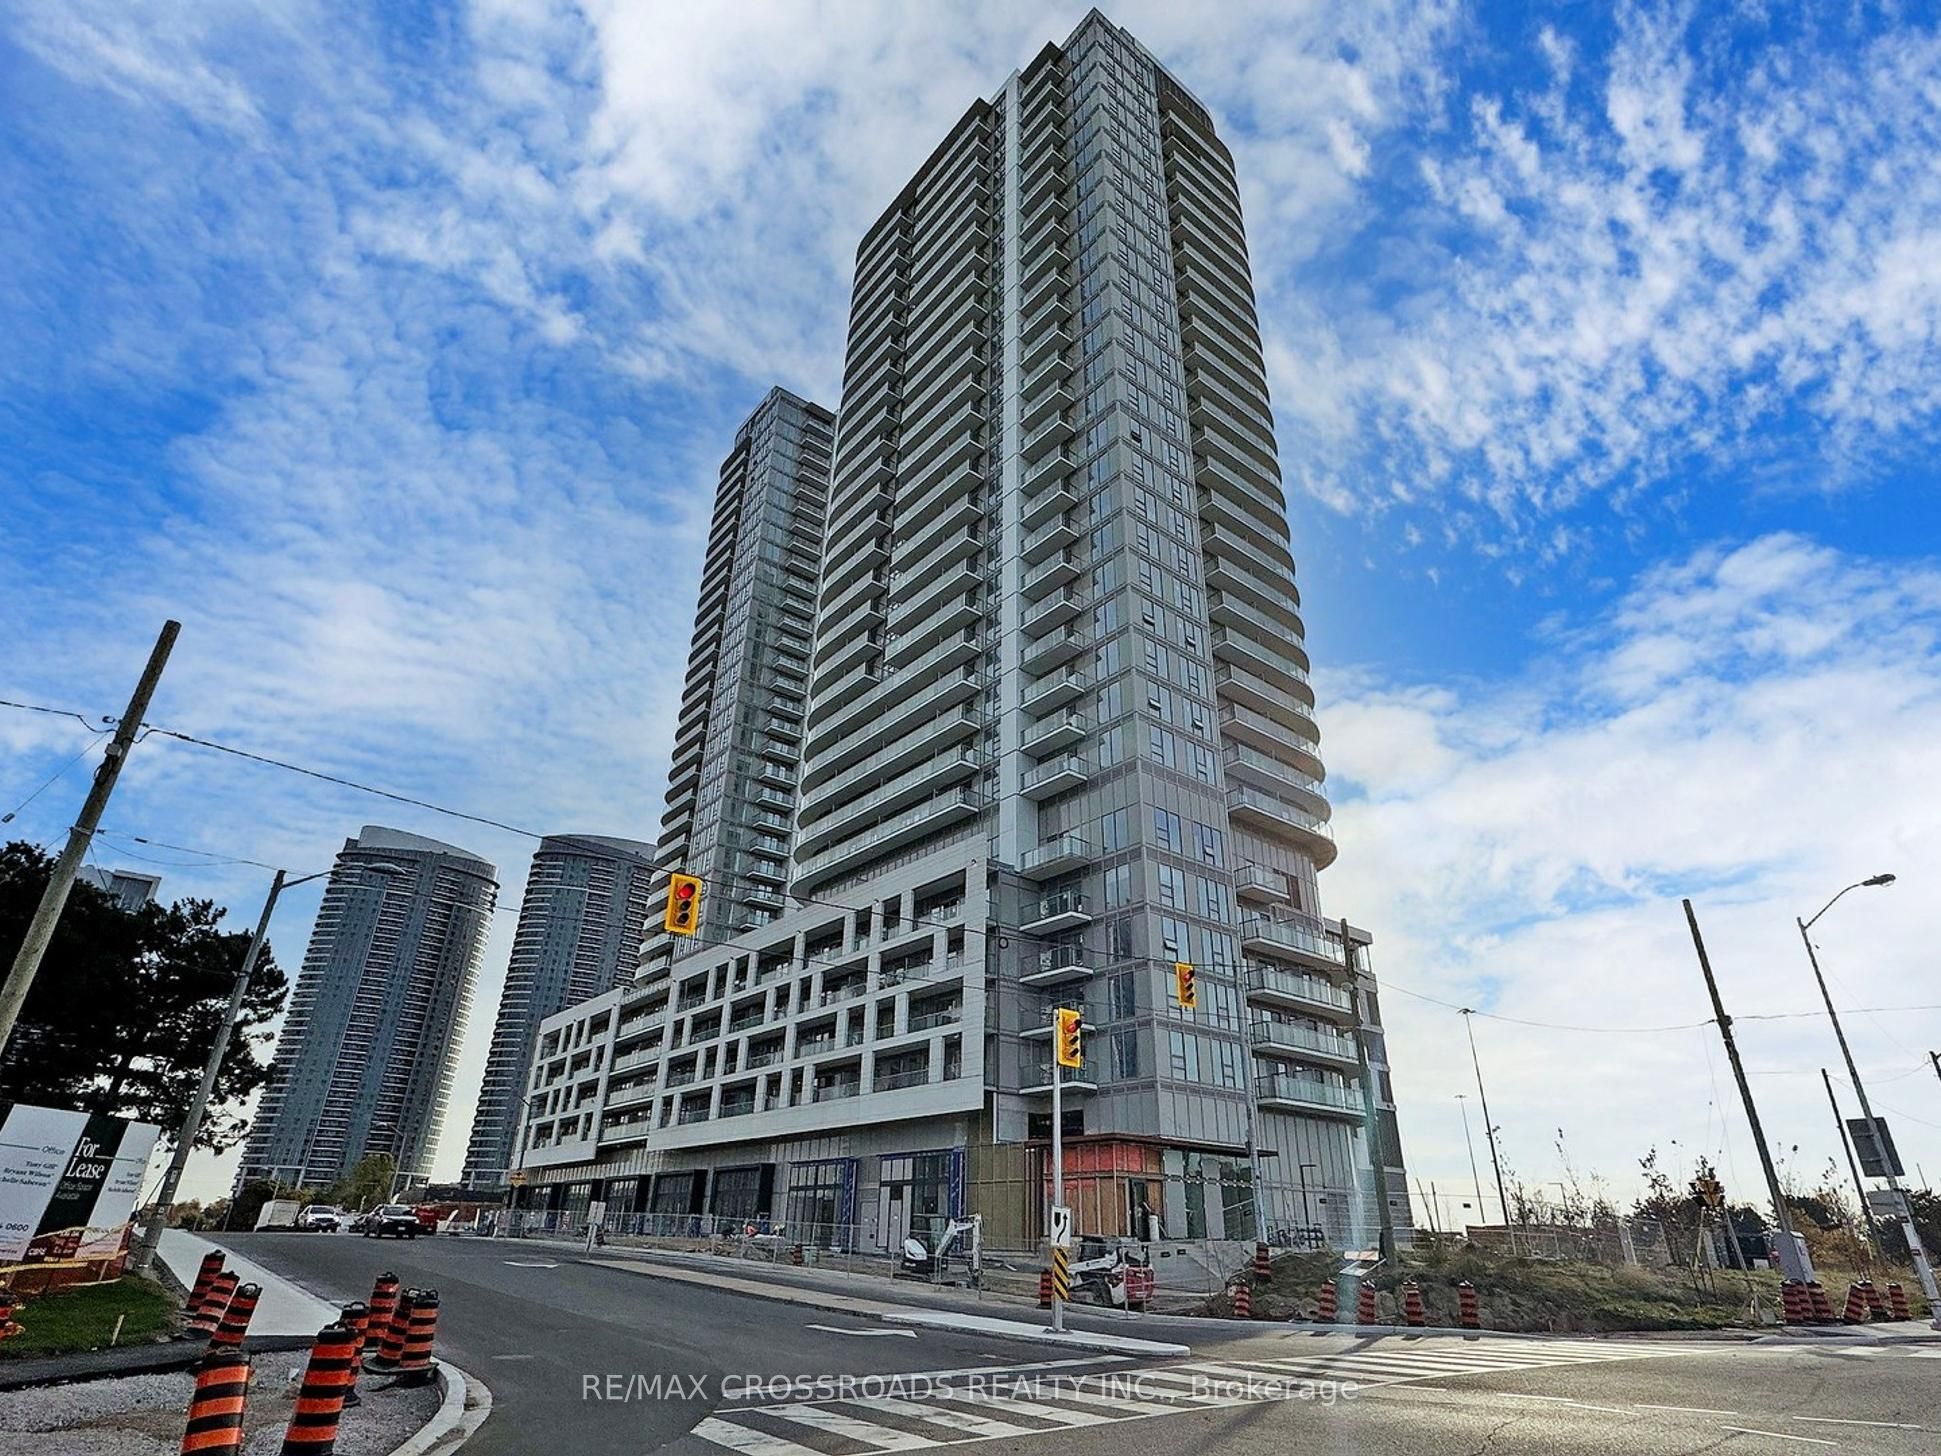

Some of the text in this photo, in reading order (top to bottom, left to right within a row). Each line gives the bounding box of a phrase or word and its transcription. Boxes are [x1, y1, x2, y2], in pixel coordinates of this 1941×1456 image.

[75, 1137, 100, 1157] For
[65, 1157, 105, 1179] Lease
[5, 1223, 29, 1232] 0600
